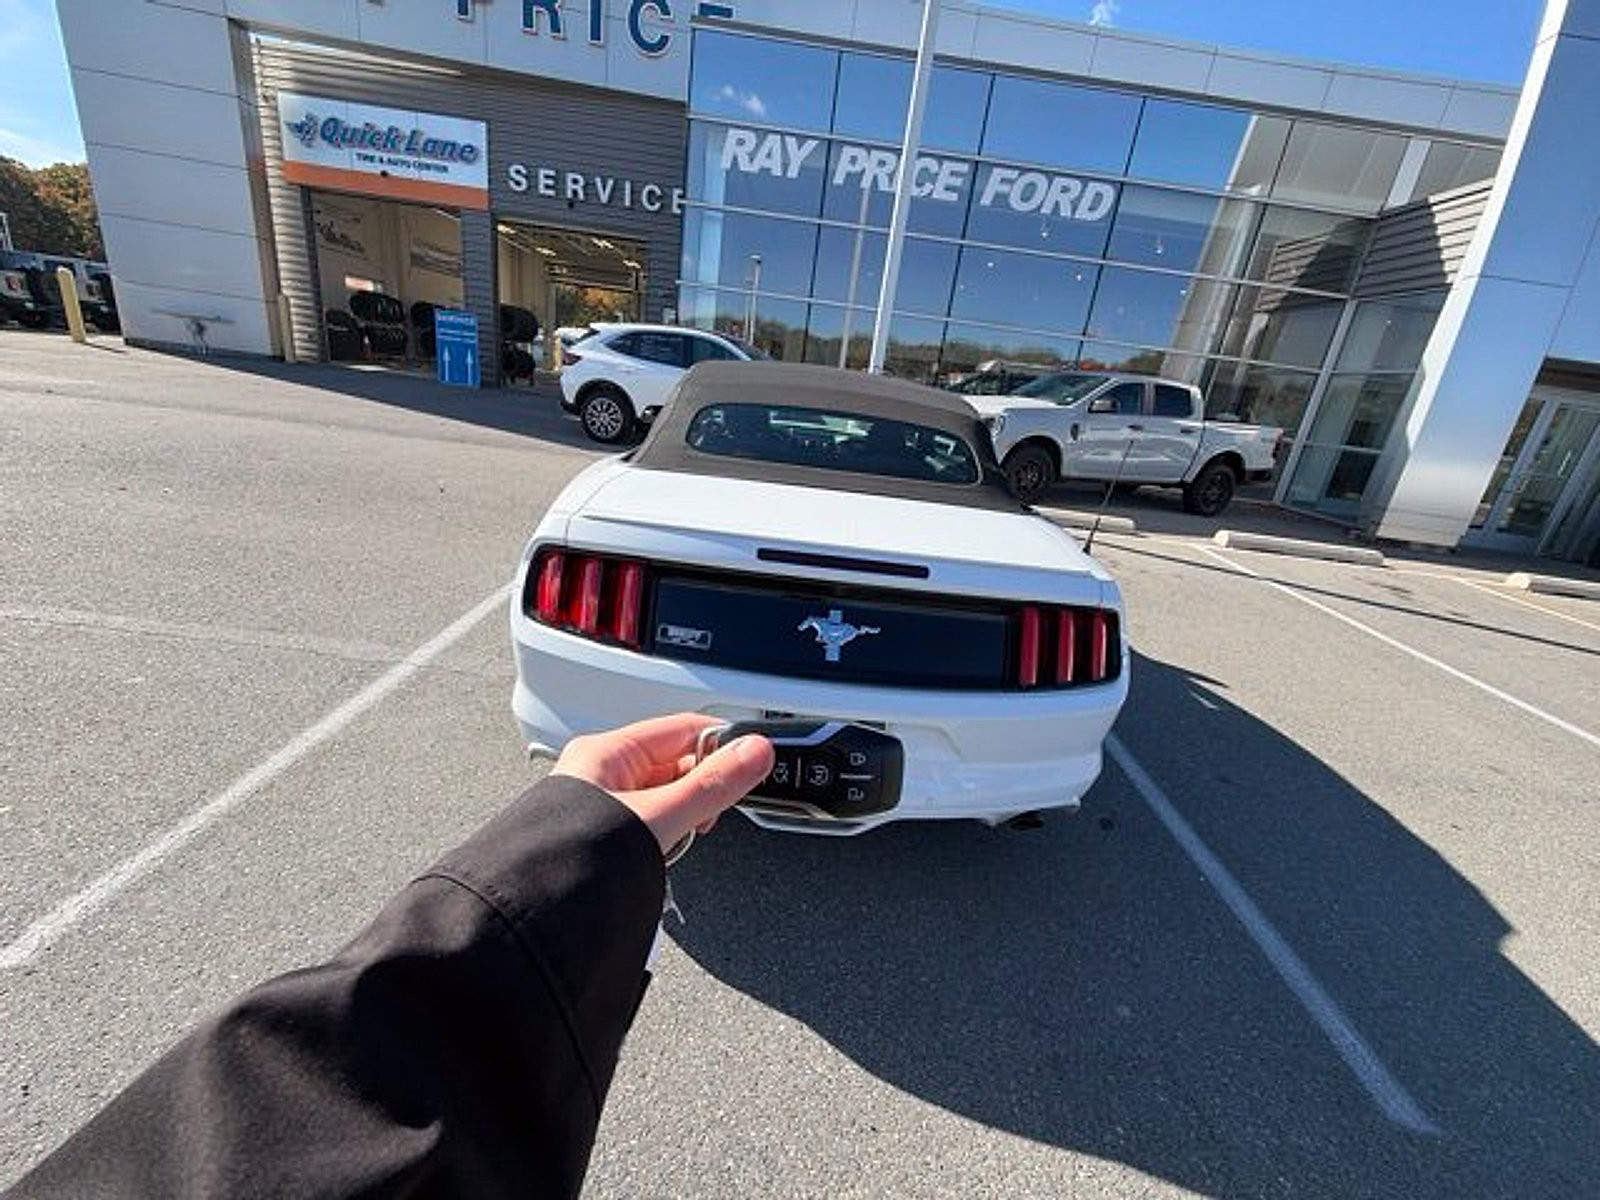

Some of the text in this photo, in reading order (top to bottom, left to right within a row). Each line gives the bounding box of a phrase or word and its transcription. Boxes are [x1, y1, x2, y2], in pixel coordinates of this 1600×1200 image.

[456, 0, 734, 57] RIC
[320, 116, 480, 165] Quick Lane
[508, 164, 685, 214] SERVICE
[721, 128, 1118, 222] RAY PRCE FORD
